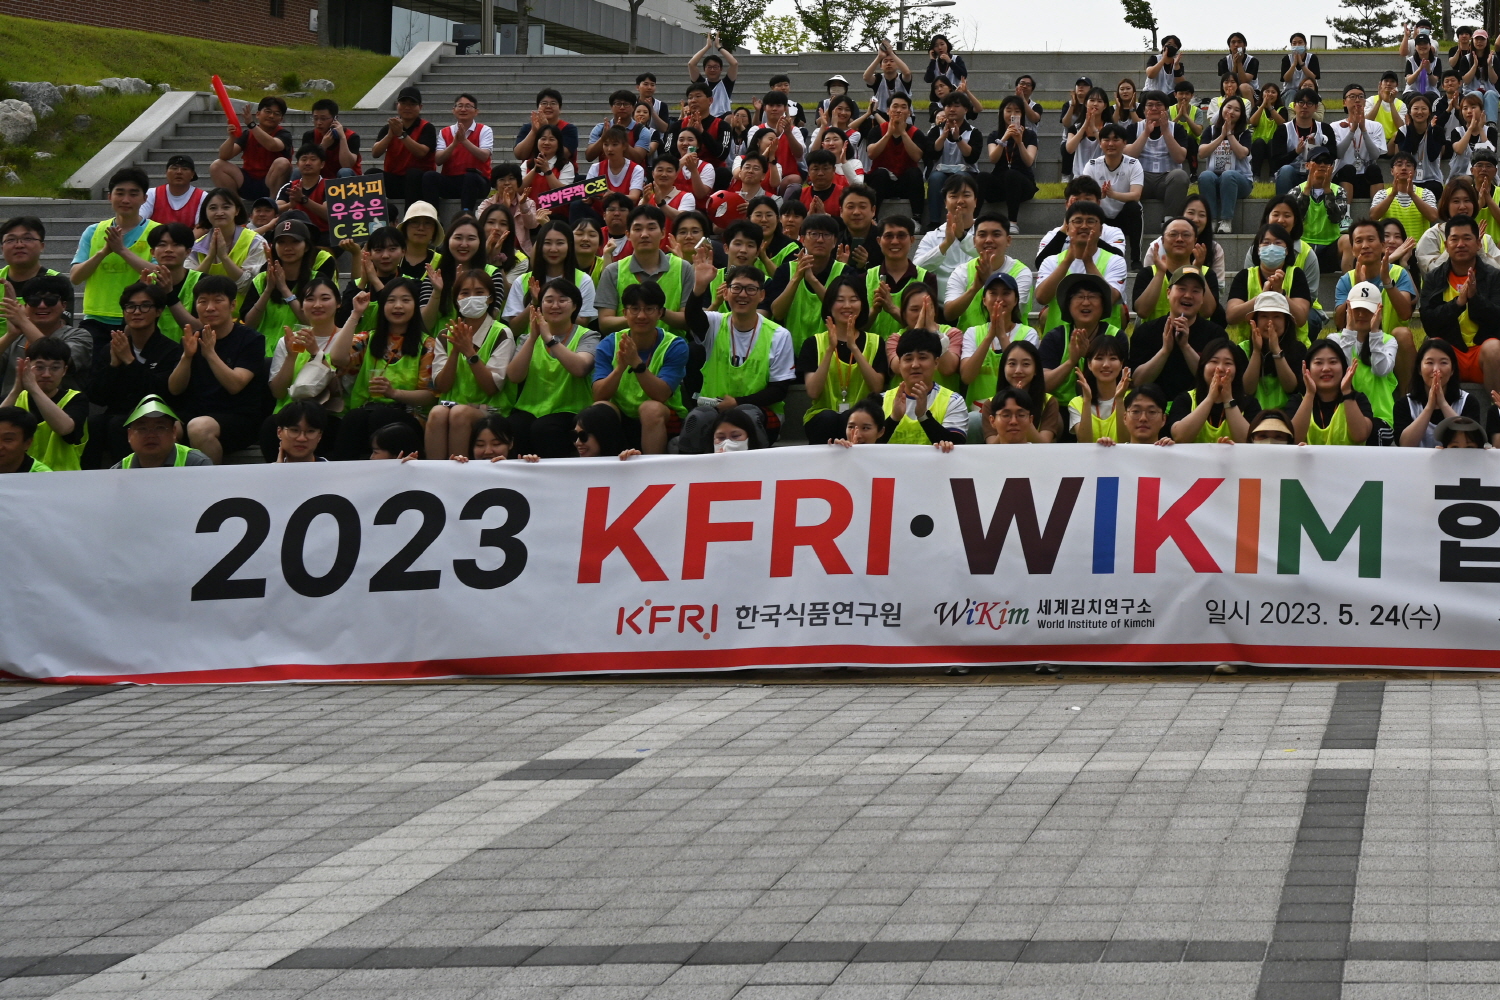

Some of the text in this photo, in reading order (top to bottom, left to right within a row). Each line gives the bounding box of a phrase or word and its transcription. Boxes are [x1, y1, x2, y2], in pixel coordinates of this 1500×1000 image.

[327, 180, 383, 200] 어차피
[330, 198, 385, 220] 우승은
[283, 221, 292, 231] B
[1361, 287, 1370, 298] S
[190, 488, 532, 602] 2023
[933, 598, 1030, 631] WiKim
[1036, 598, 1153, 616] 세계김치연구소
[1205, 599, 1250, 626] 일시
[1259, 601, 1328, 626] 2023.
[1338, 603, 1360, 626] 5.
[616, 600, 902, 639] KFRI 한국식품연구원
[1037, 617, 1155, 629] World Institute of Kimchi
